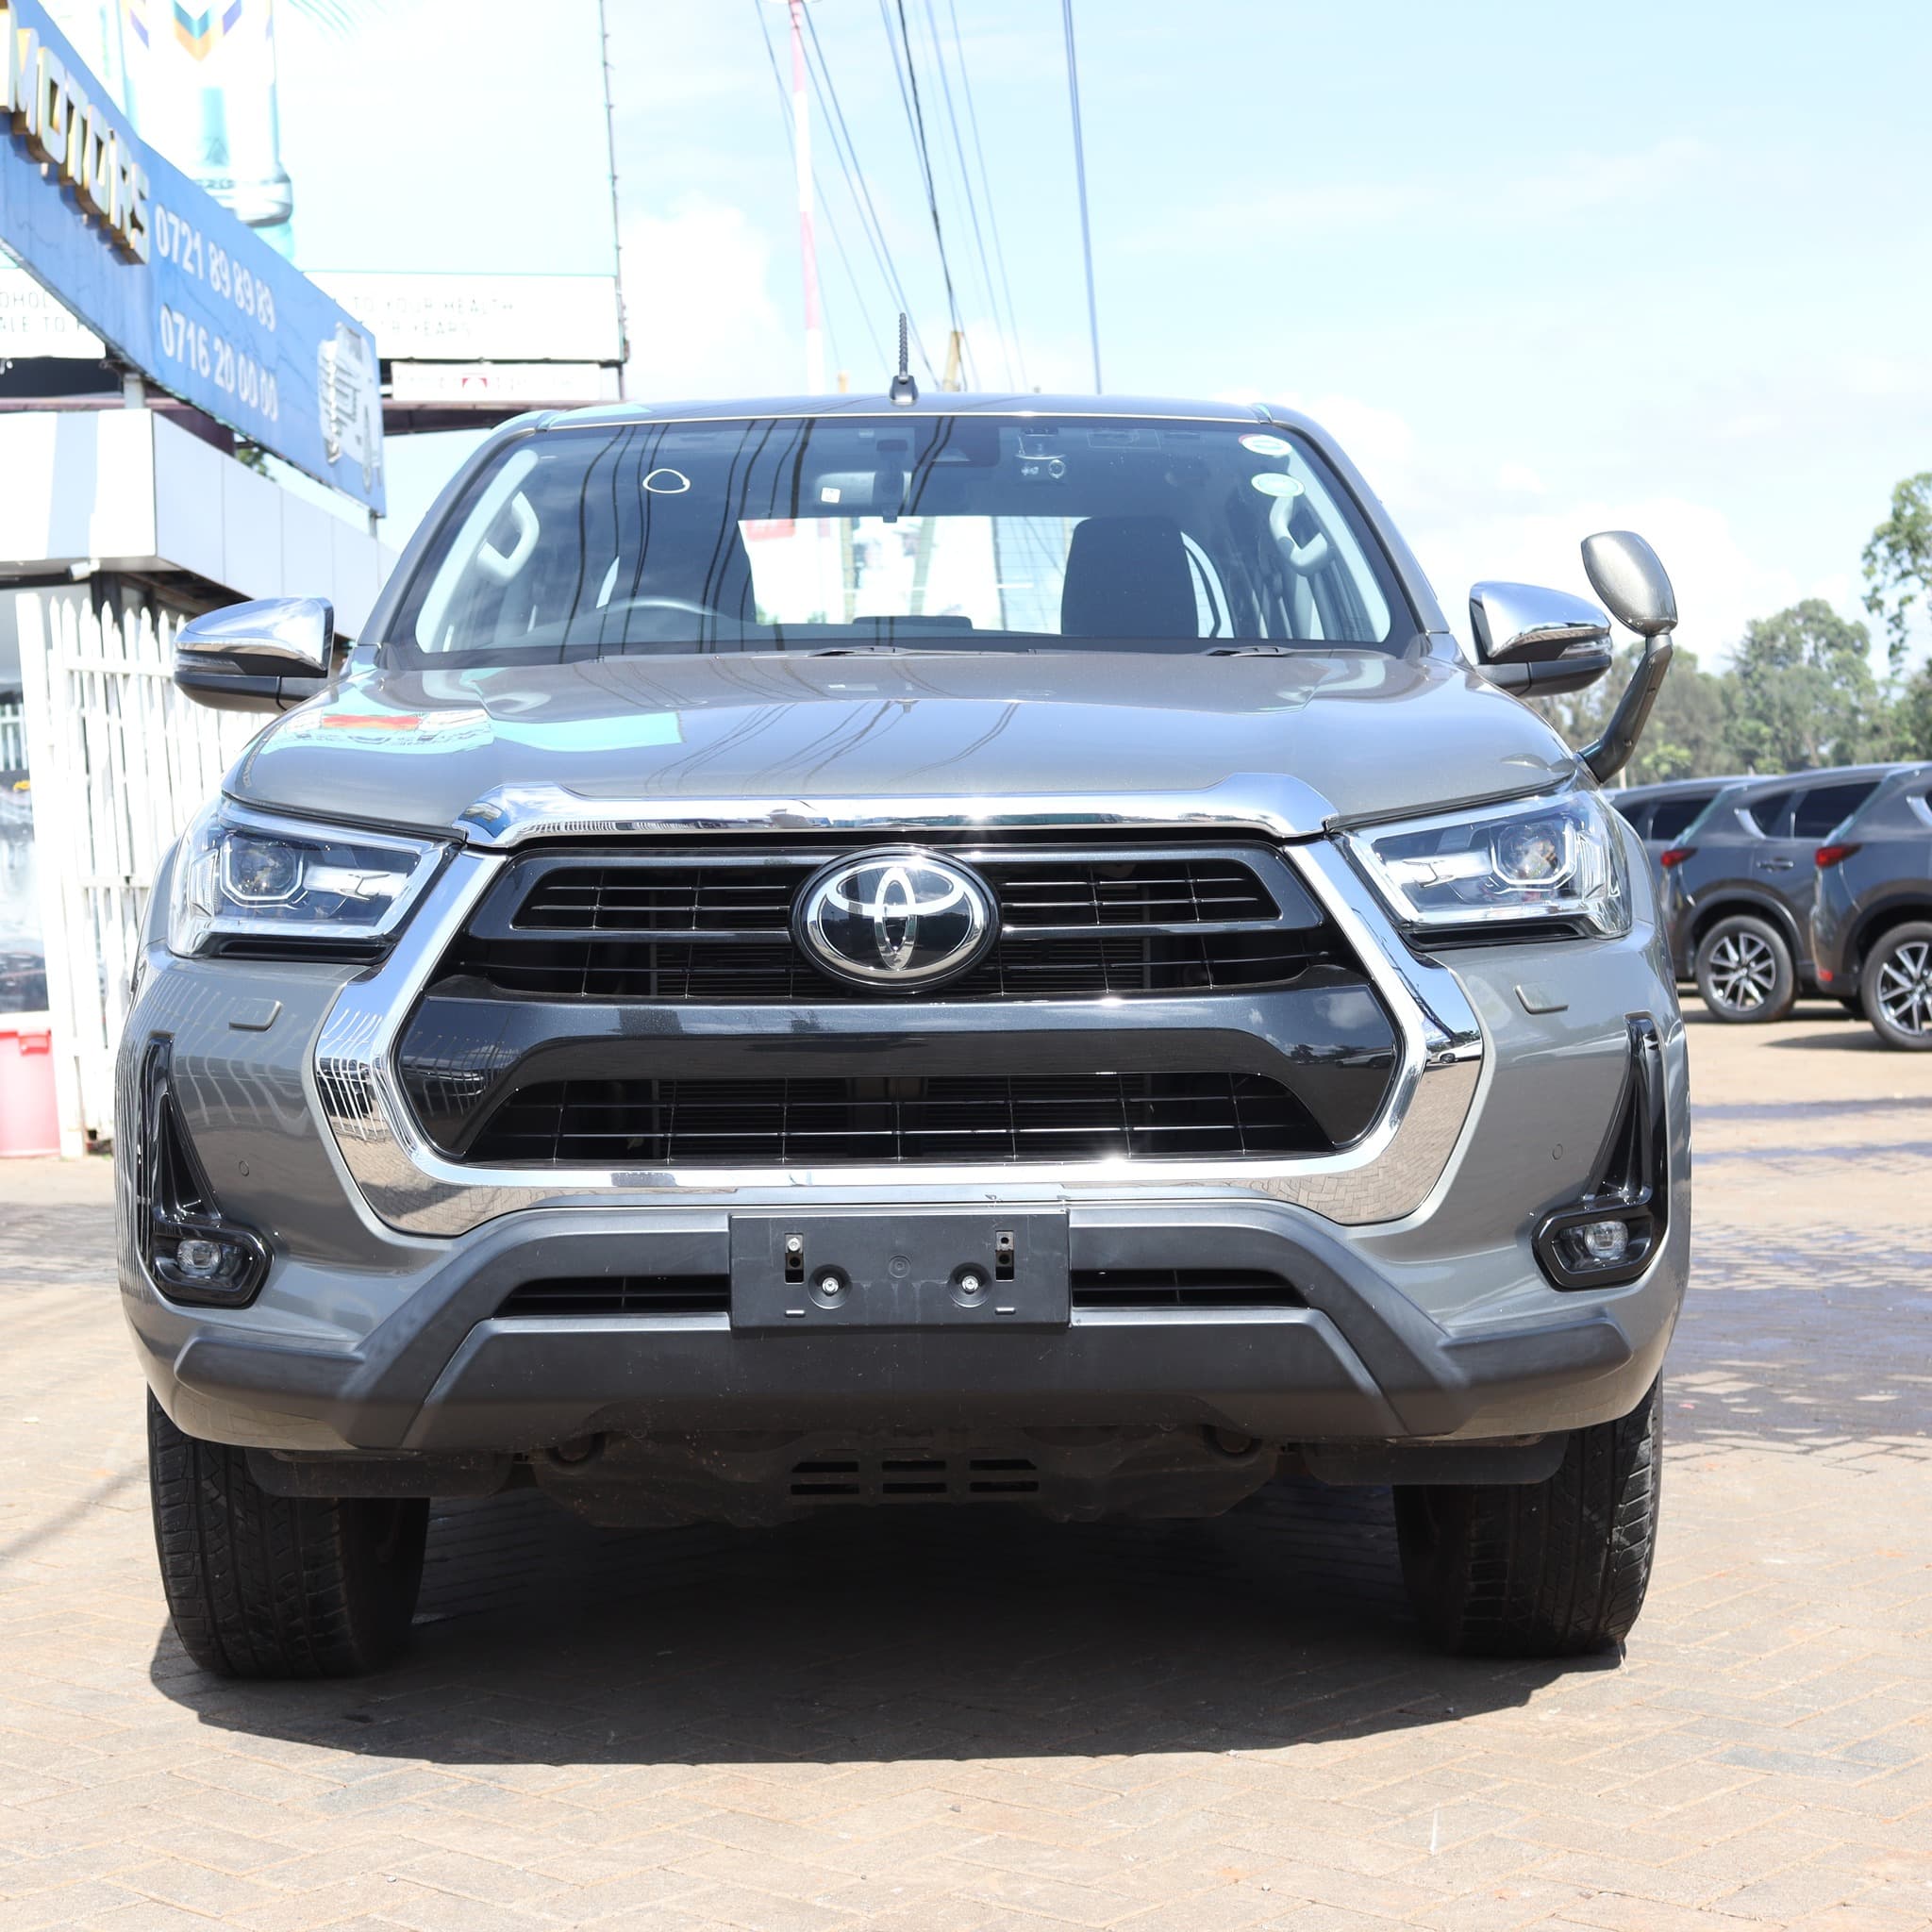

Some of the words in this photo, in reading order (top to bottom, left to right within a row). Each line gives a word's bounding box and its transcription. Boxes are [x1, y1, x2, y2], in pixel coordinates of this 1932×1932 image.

[2, 0, 150, 265] MOTORS
[155, 203, 205, 280] 0721
[208, 241, 232, 299] 89
[233, 260, 256, 316] 89
[256, 278, 276, 332] 89
[443, 295, 514, 315] HEALTH
[159, 304, 211, 378] 0716
[214, 336, 236, 394] 20
[238, 353, 259, 408] 00
[259, 368, 279, 422] 00
